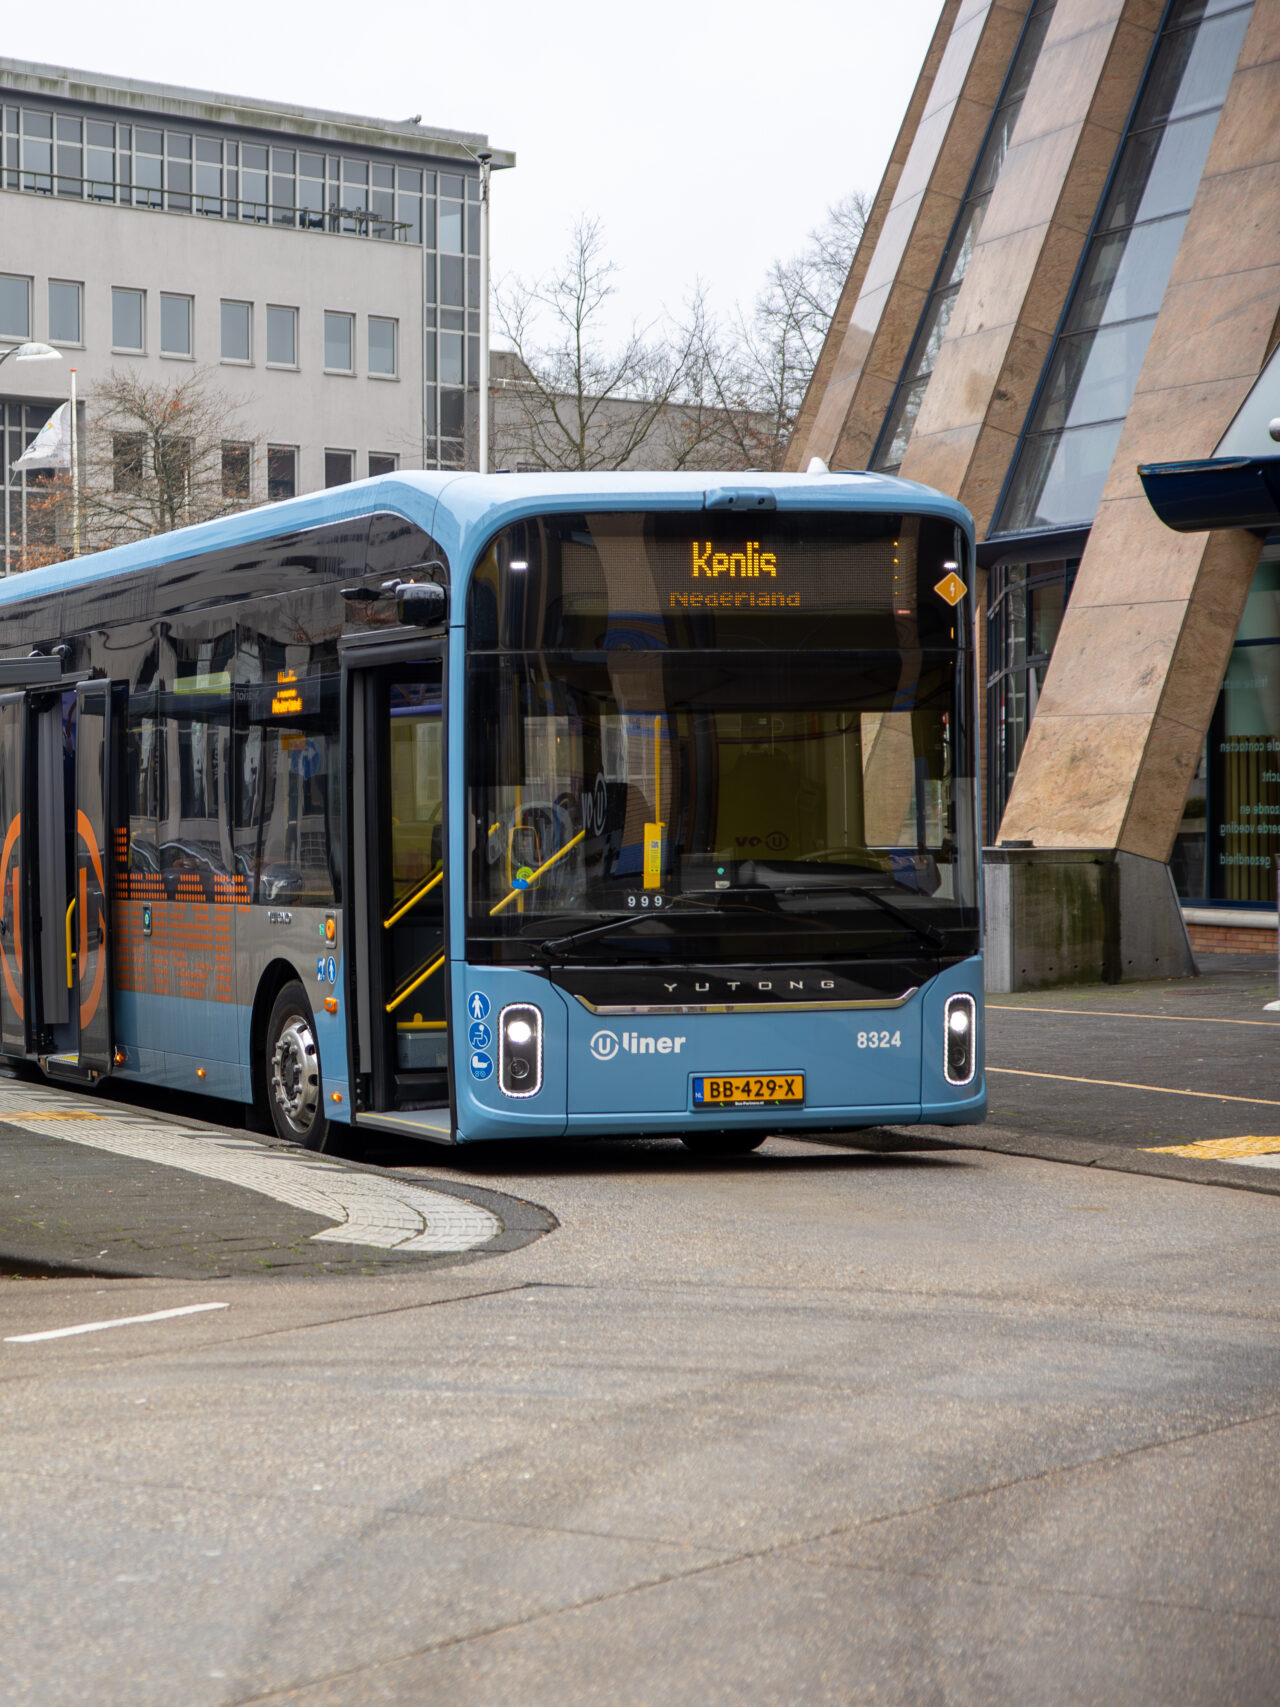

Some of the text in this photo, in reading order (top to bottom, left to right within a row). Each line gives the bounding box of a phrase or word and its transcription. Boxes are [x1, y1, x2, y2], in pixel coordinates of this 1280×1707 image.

[670, 591, 801, 608] Nederland
[628, 896, 663, 907] 999
[664, 980, 835, 993] YUTONG
[856, 1031, 902, 1048] 8324
[709, 1079, 795, 1099] BB-429-X
